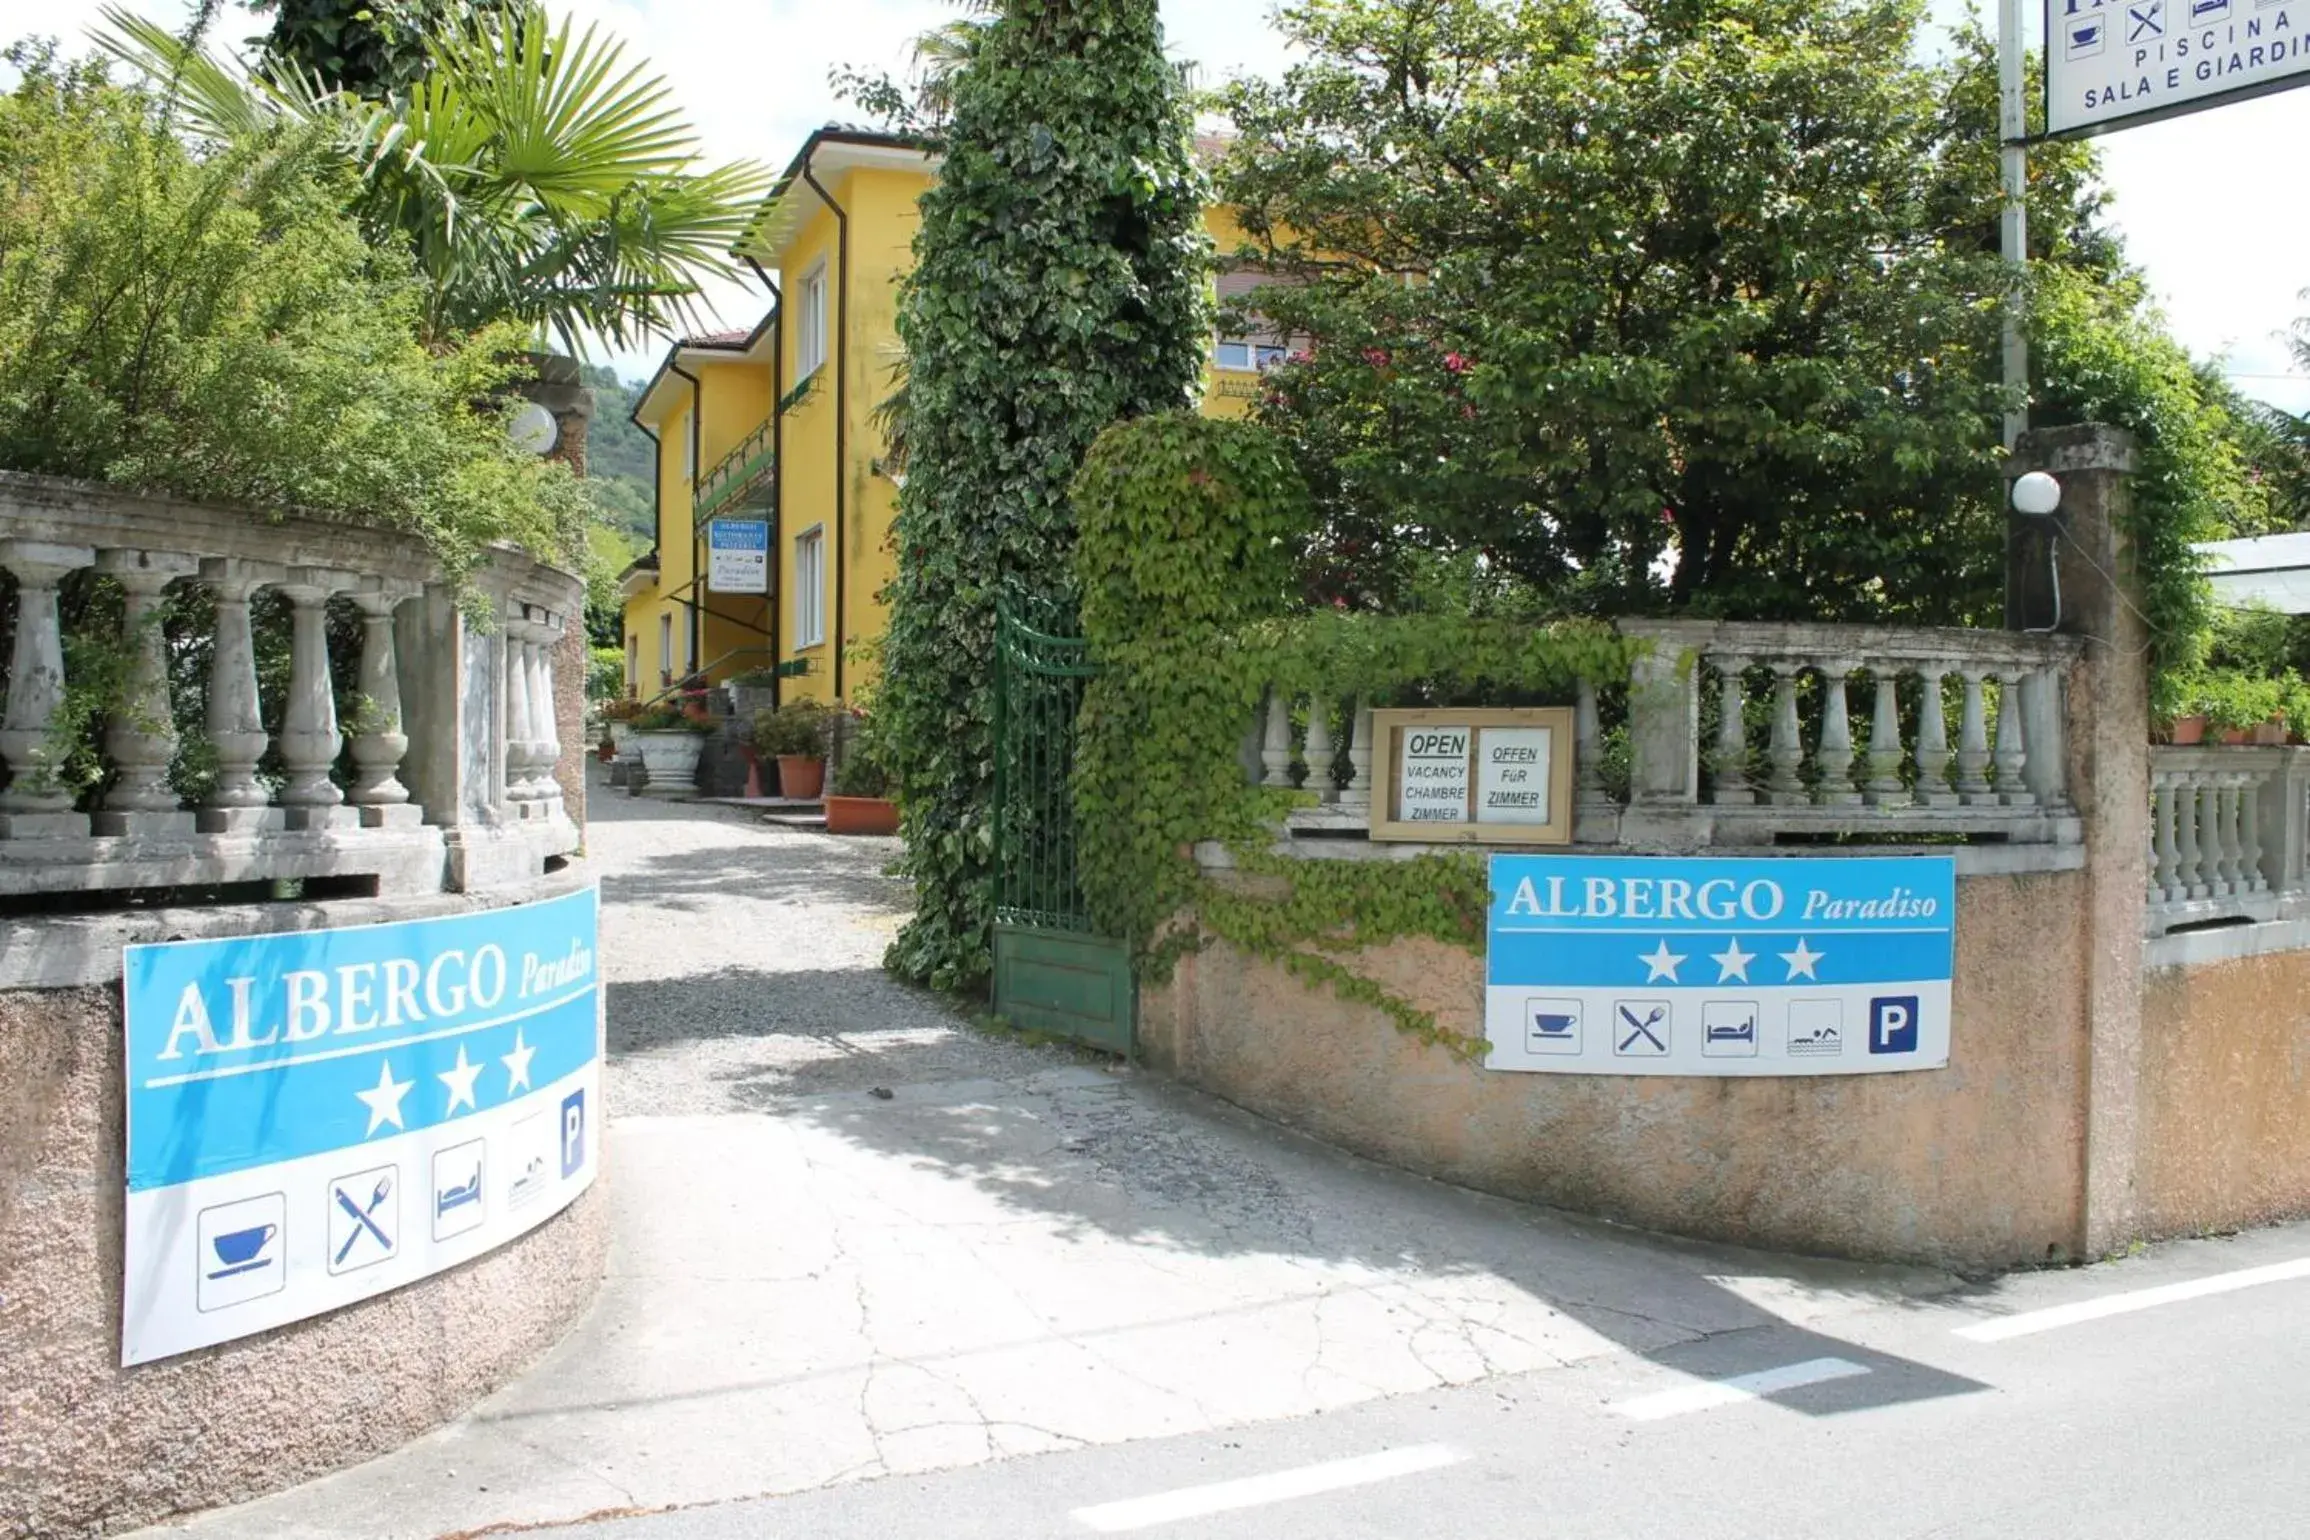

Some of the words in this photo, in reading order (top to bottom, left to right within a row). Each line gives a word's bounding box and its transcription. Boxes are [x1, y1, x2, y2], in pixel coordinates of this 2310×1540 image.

[2135, 10, 2290, 67] PISCINA
[2084, 76, 2151, 109] SALA
[2167, 68, 2180, 89] E
[1410, 734, 1466, 754] OPEN
[1493, 747, 1538, 760] OFFEN
[1407, 766, 1465, 778] VACANCY
[1405, 786, 1465, 799] CHAMBRE
[1488, 791, 1540, 805] ZIMMER
[1411, 807, 1458, 820] ZIMMER
[1505, 875, 1785, 921] ALBERGO
[1801, 888, 1938, 920] Paradiso
[156, 943, 507, 1061] ALBERGO
[1881, 1004, 1908, 1046] P
[566, 1104, 580, 1166] P
